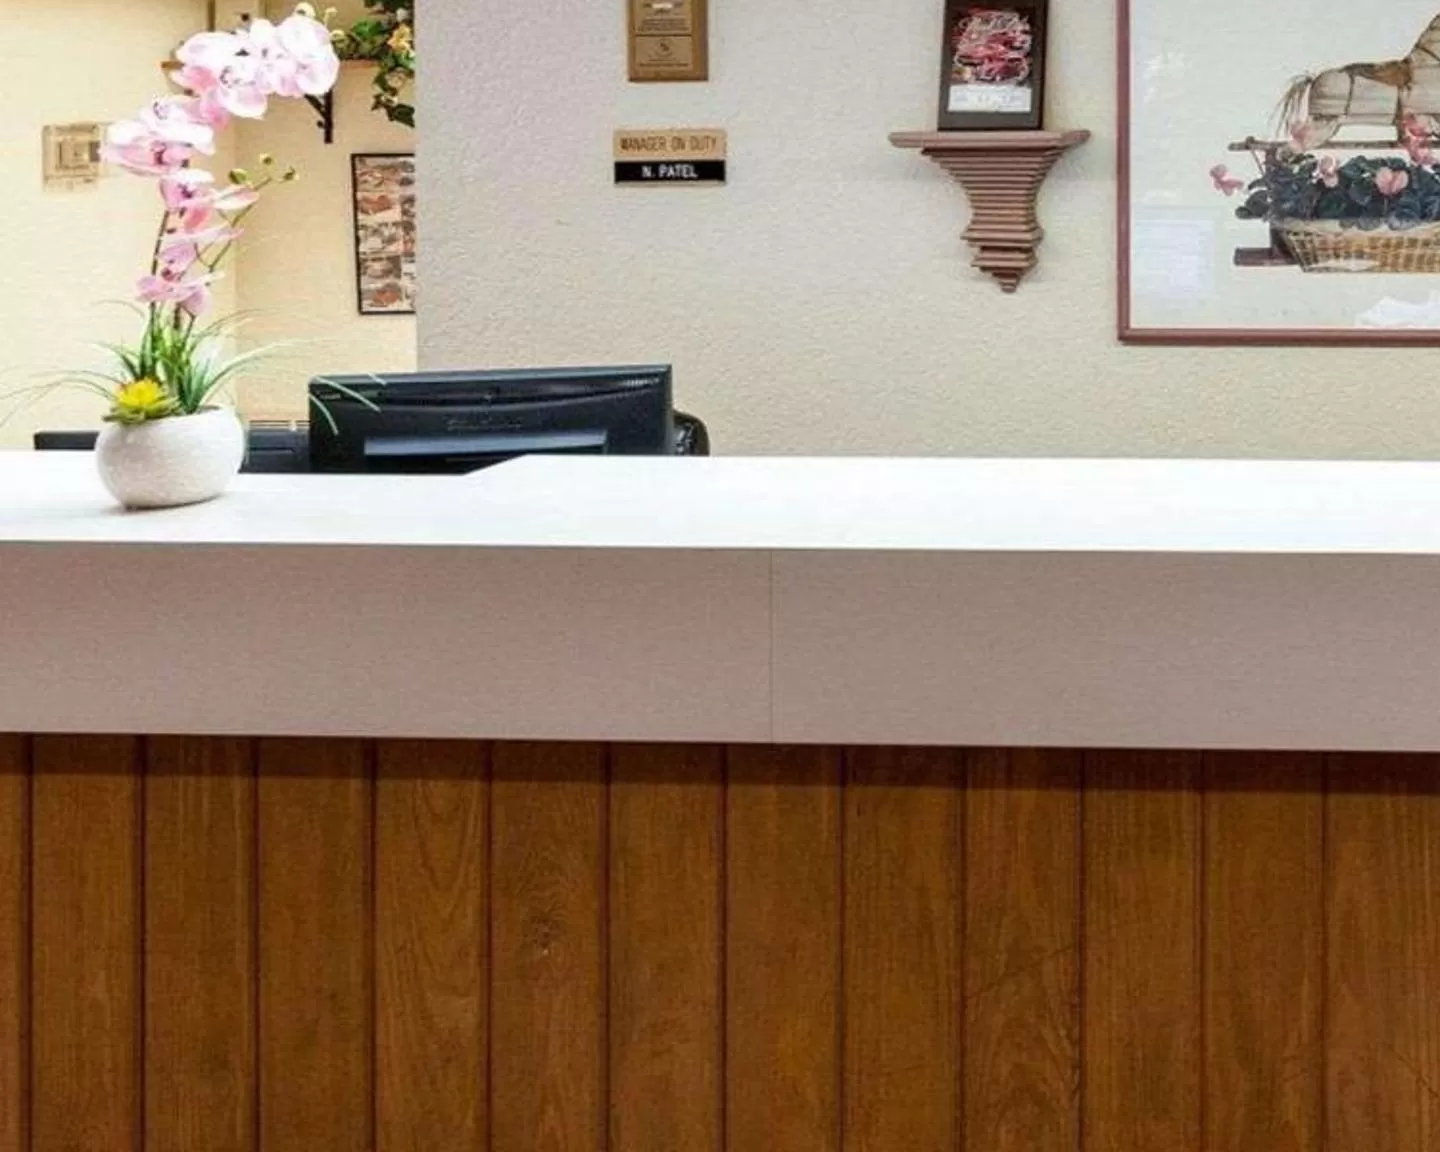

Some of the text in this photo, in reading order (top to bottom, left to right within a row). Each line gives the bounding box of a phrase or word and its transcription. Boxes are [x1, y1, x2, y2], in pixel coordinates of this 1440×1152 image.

[621, 135, 717, 152] MANAGER ON DUTY
[641, 163, 699, 178] N. PATEL
